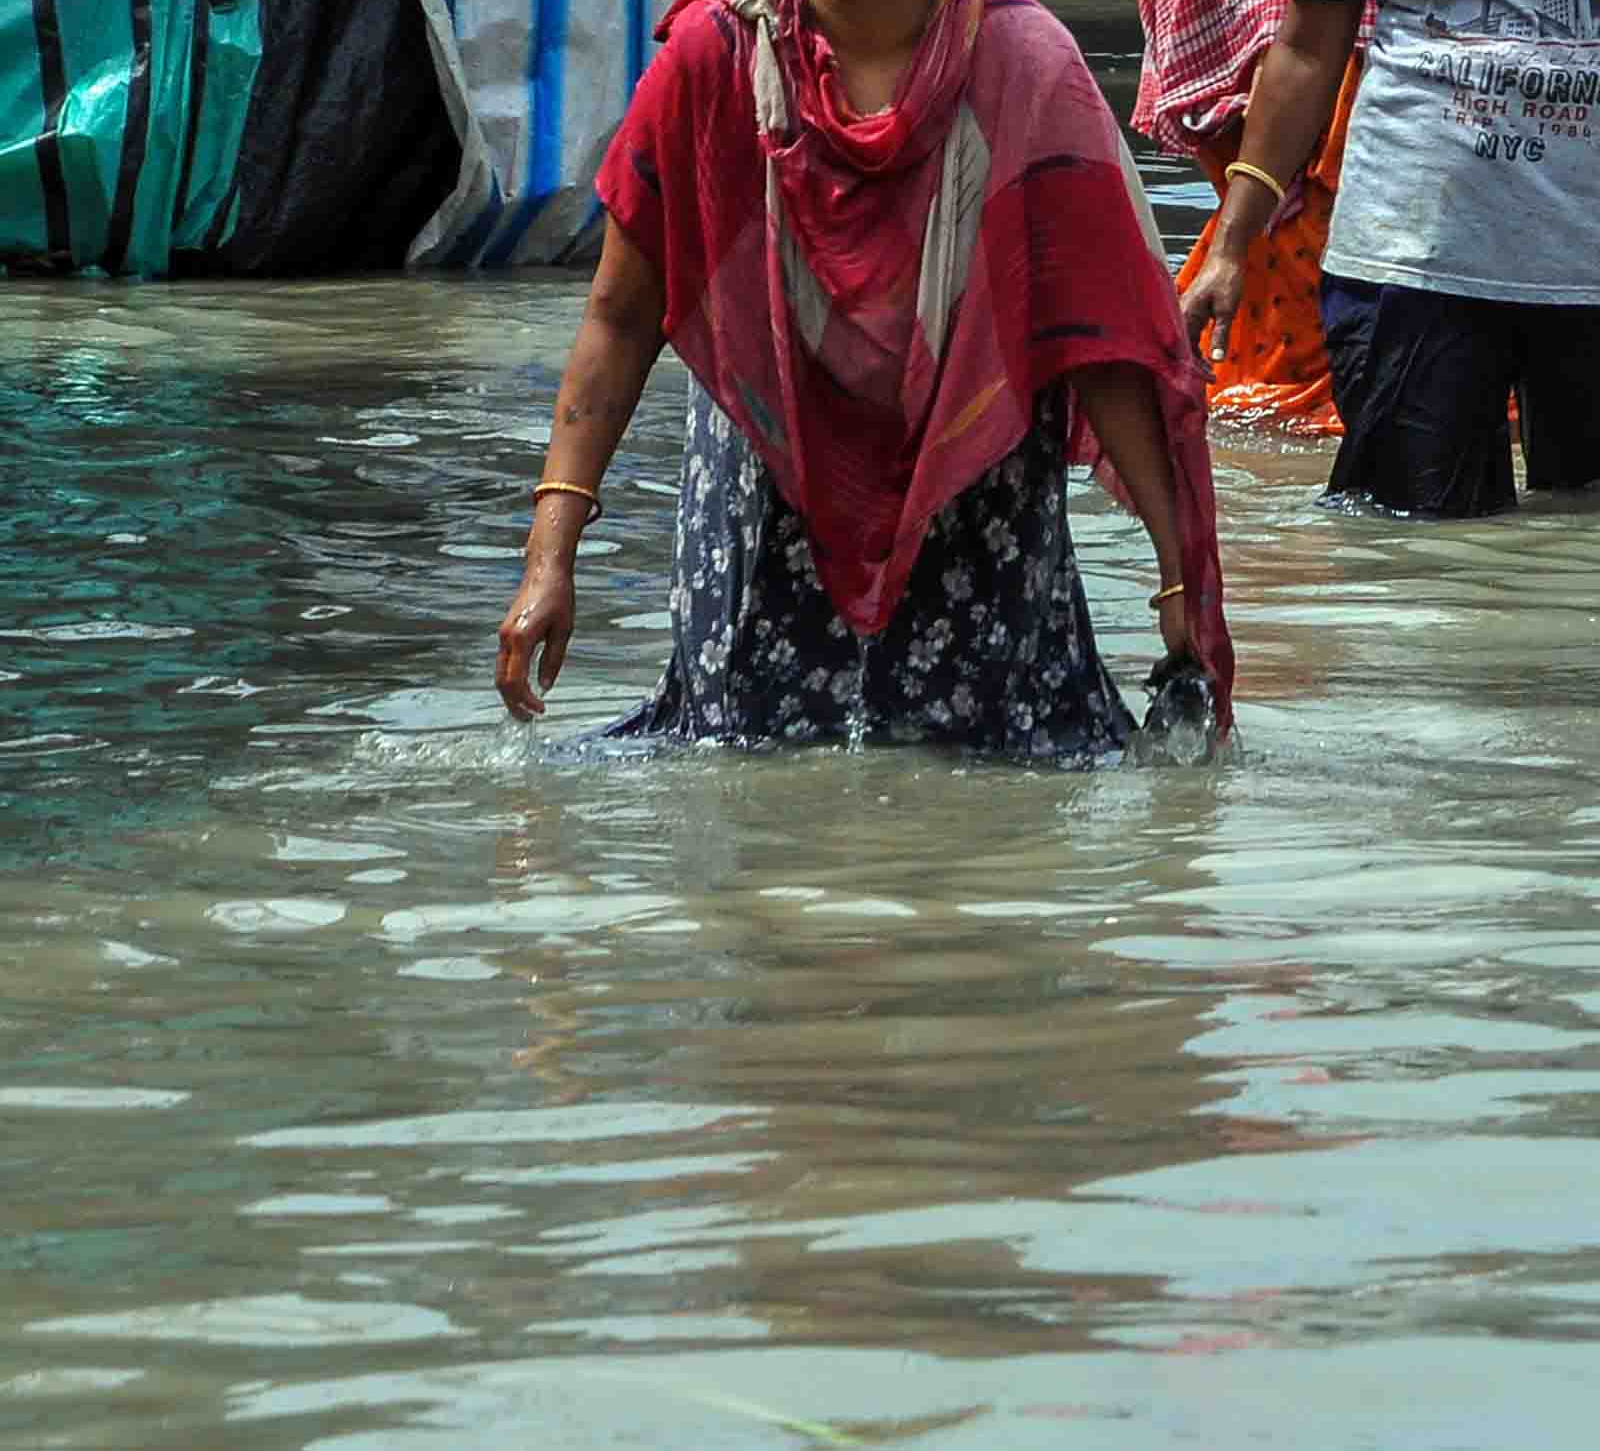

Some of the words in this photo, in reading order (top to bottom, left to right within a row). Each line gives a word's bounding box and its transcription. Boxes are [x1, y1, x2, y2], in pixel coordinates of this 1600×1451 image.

[1453, 91, 1508, 116] HIGH
[1522, 101, 1588, 122] ROAD
[1475, 131, 1546, 163] NYC
